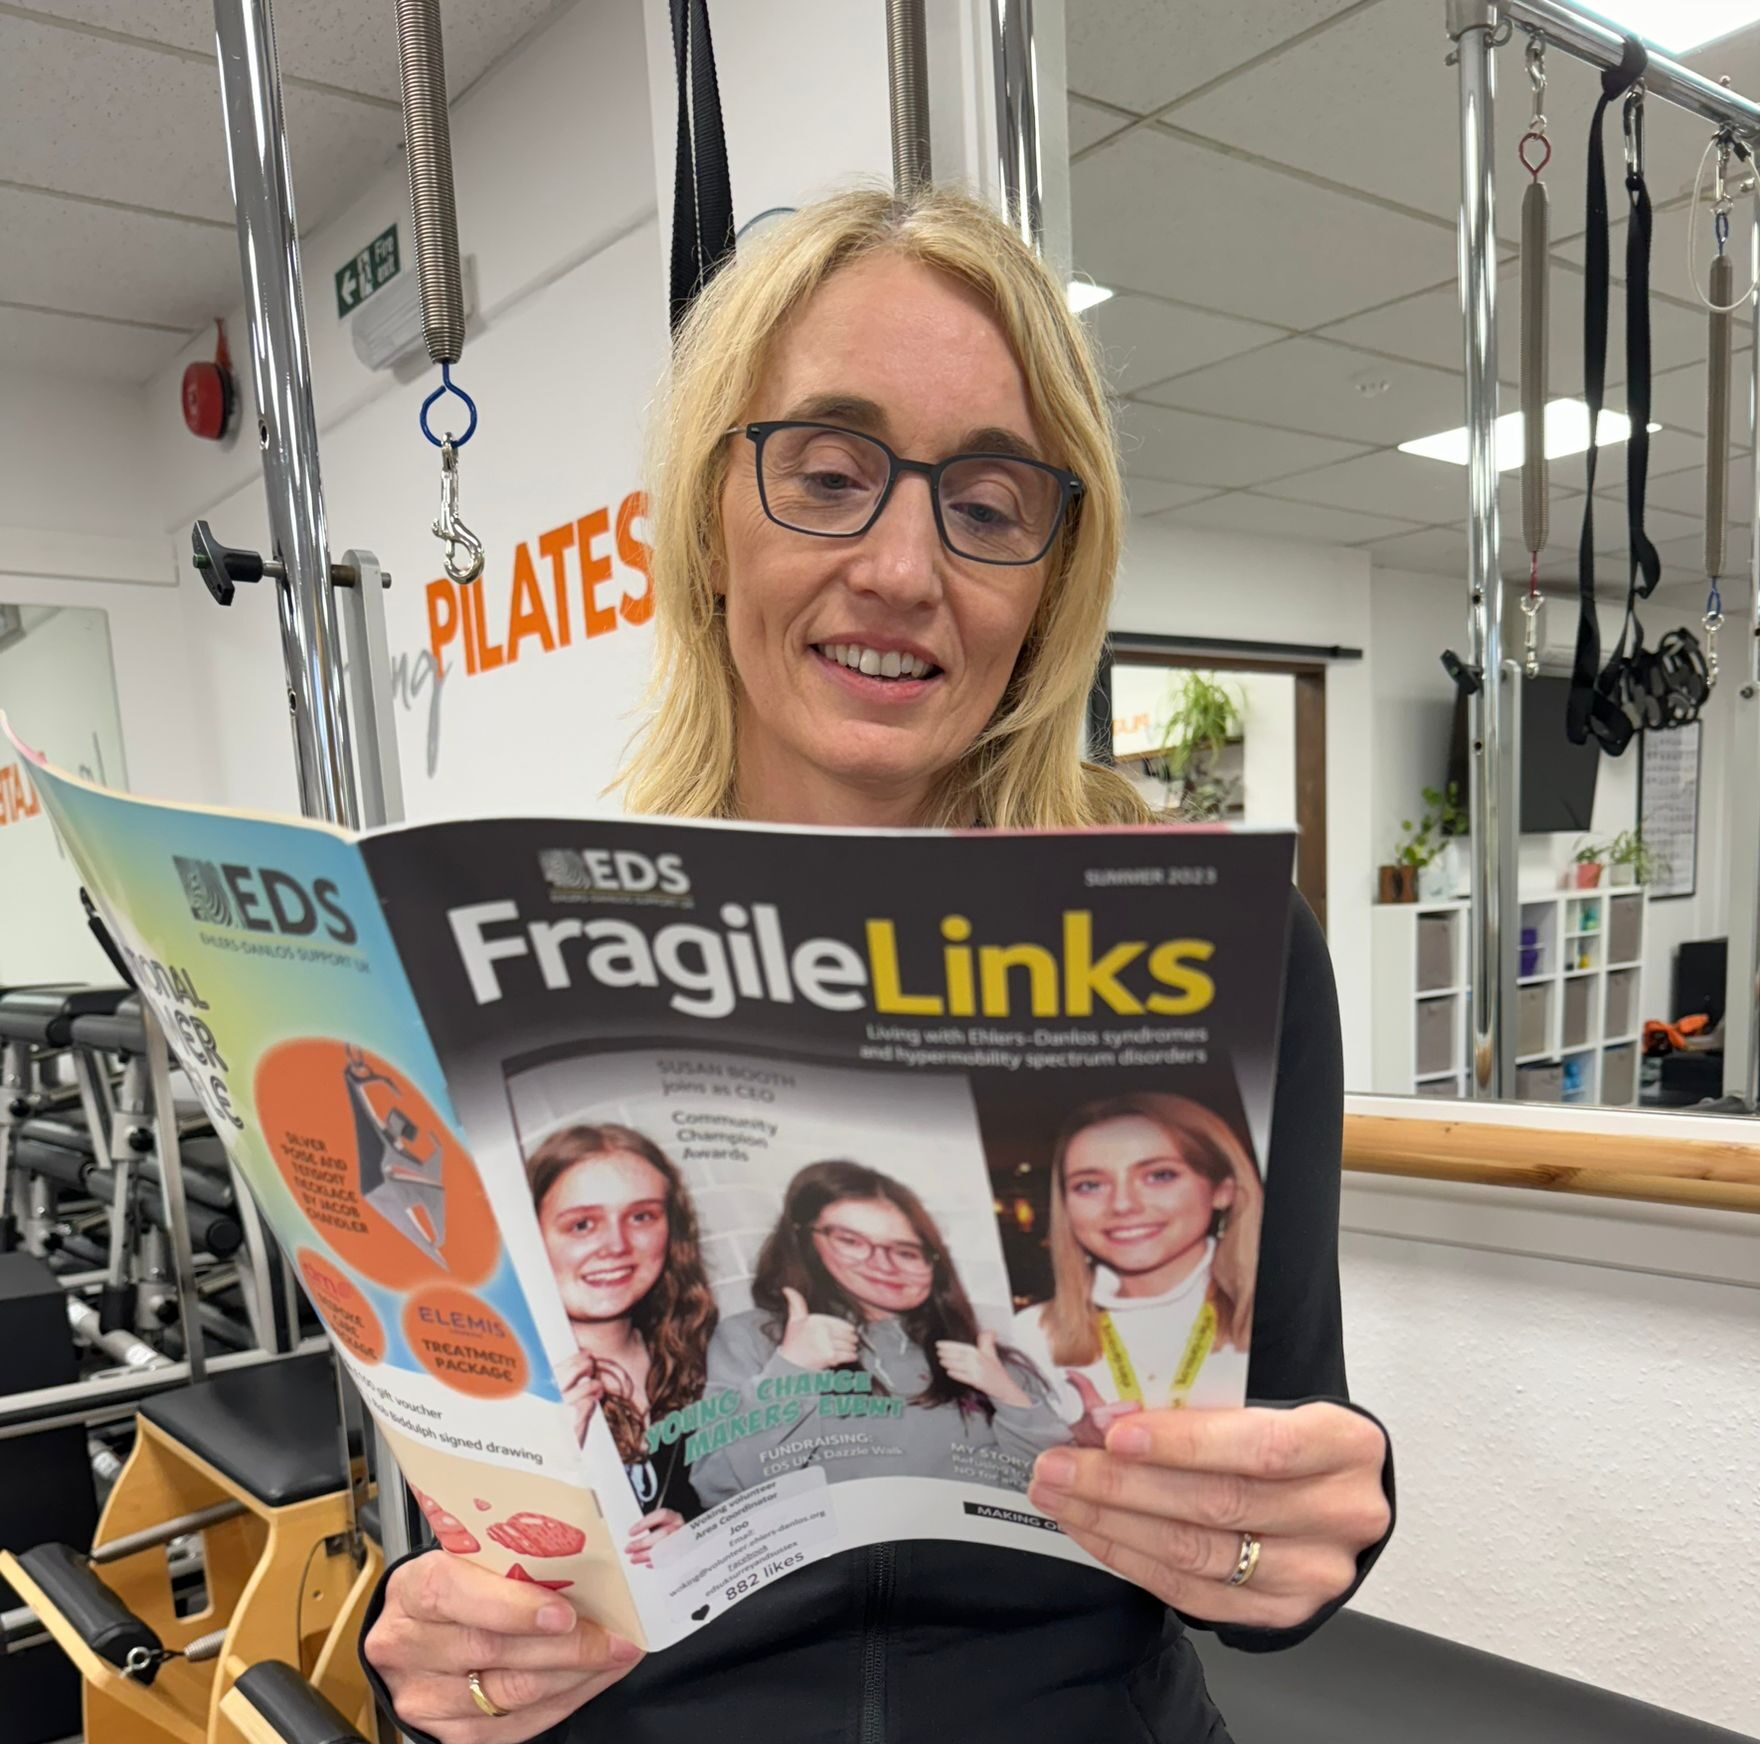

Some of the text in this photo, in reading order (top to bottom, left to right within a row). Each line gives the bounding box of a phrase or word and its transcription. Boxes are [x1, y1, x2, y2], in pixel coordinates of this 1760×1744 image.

[425, 489, 655, 677] PILATES
[583, 849, 691, 895] EDS
[1084, 867, 1164, 887] SUMMER
[220, 863, 358, 946] EDS
[865, 1023, 1209, 1049] Living with Ehlers-Danlos syndromes
[859, 1045, 1208, 1071] and hypermobility spectrum disorders
[662, 1079, 776, 1104] joins as CEO
[671, 1110, 779, 1137] Community
[682, 1147, 750, 1163] Awards
[418, 1305, 507, 1339] ELEMIS
[434, 1357, 513, 1383] PACKAGE
[394, 1396, 443, 1421] voucher
[645, 1369, 872, 1455] YOUNG CHANGE
[683, 1394, 905, 1467] MAKERS EVENT
[439, 1432, 483, 1452] signed
[486, 1441, 544, 1466] drawing
[763, 1460, 790, 1477] EDS
[823, 1446, 869, 1460] Dazzle
[690, 1481, 778, 1531] Woking volunteer
[694, 1492, 779, 1541] Area Coordinator
[976, 1506, 1042, 1527] MAKING
[725, 1550, 805, 1602] 882 likes
